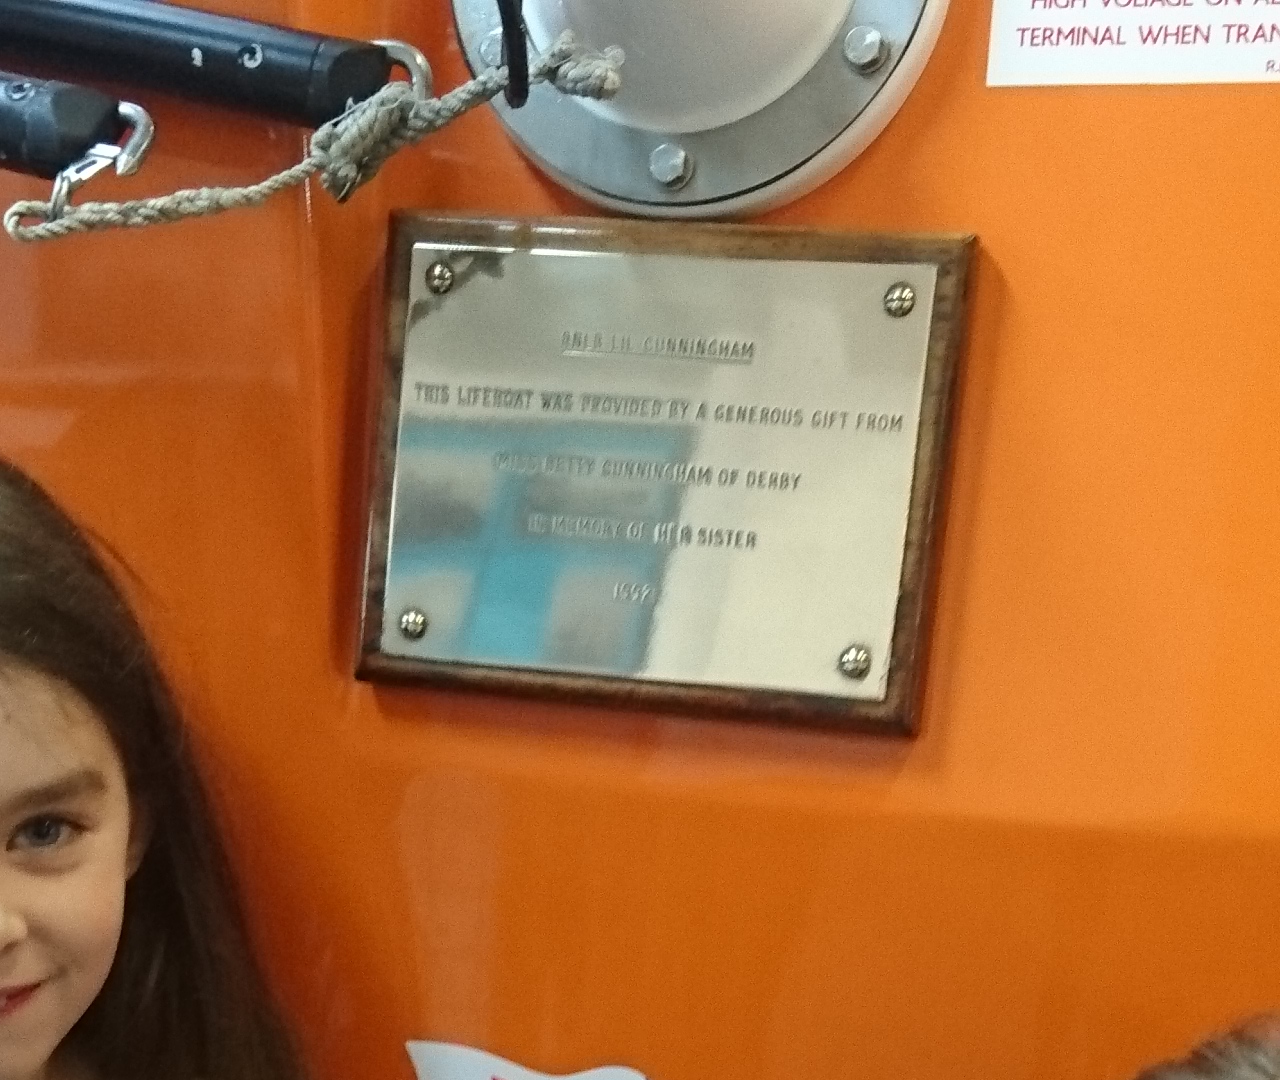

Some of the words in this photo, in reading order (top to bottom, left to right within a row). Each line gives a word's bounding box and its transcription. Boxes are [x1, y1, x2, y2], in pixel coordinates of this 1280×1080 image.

[1016, 25, 1127, 47] TERMINAL
[1138, 24, 1212, 45] WHEN
[643, 336, 755, 359] CUNNINGHAM
[414, 382, 450, 405] THIS
[457, 385, 534, 409] LIFEBOAT
[540, 391, 574, 412] WAS
[580, 392, 662, 418] PROVIDED
[668, 400, 689, 419] BY
[695, 402, 707, 421] A
[714, 403, 804, 427] GENEROUS
[811, 409, 850, 430] GIFT
[855, 412, 904, 432] FROM
[601, 459, 713, 485] CUNNINGHAM
[718, 468, 740, 486] OF
[746, 468, 803, 491] DERBY
[697, 526, 757, 549] SISTER
